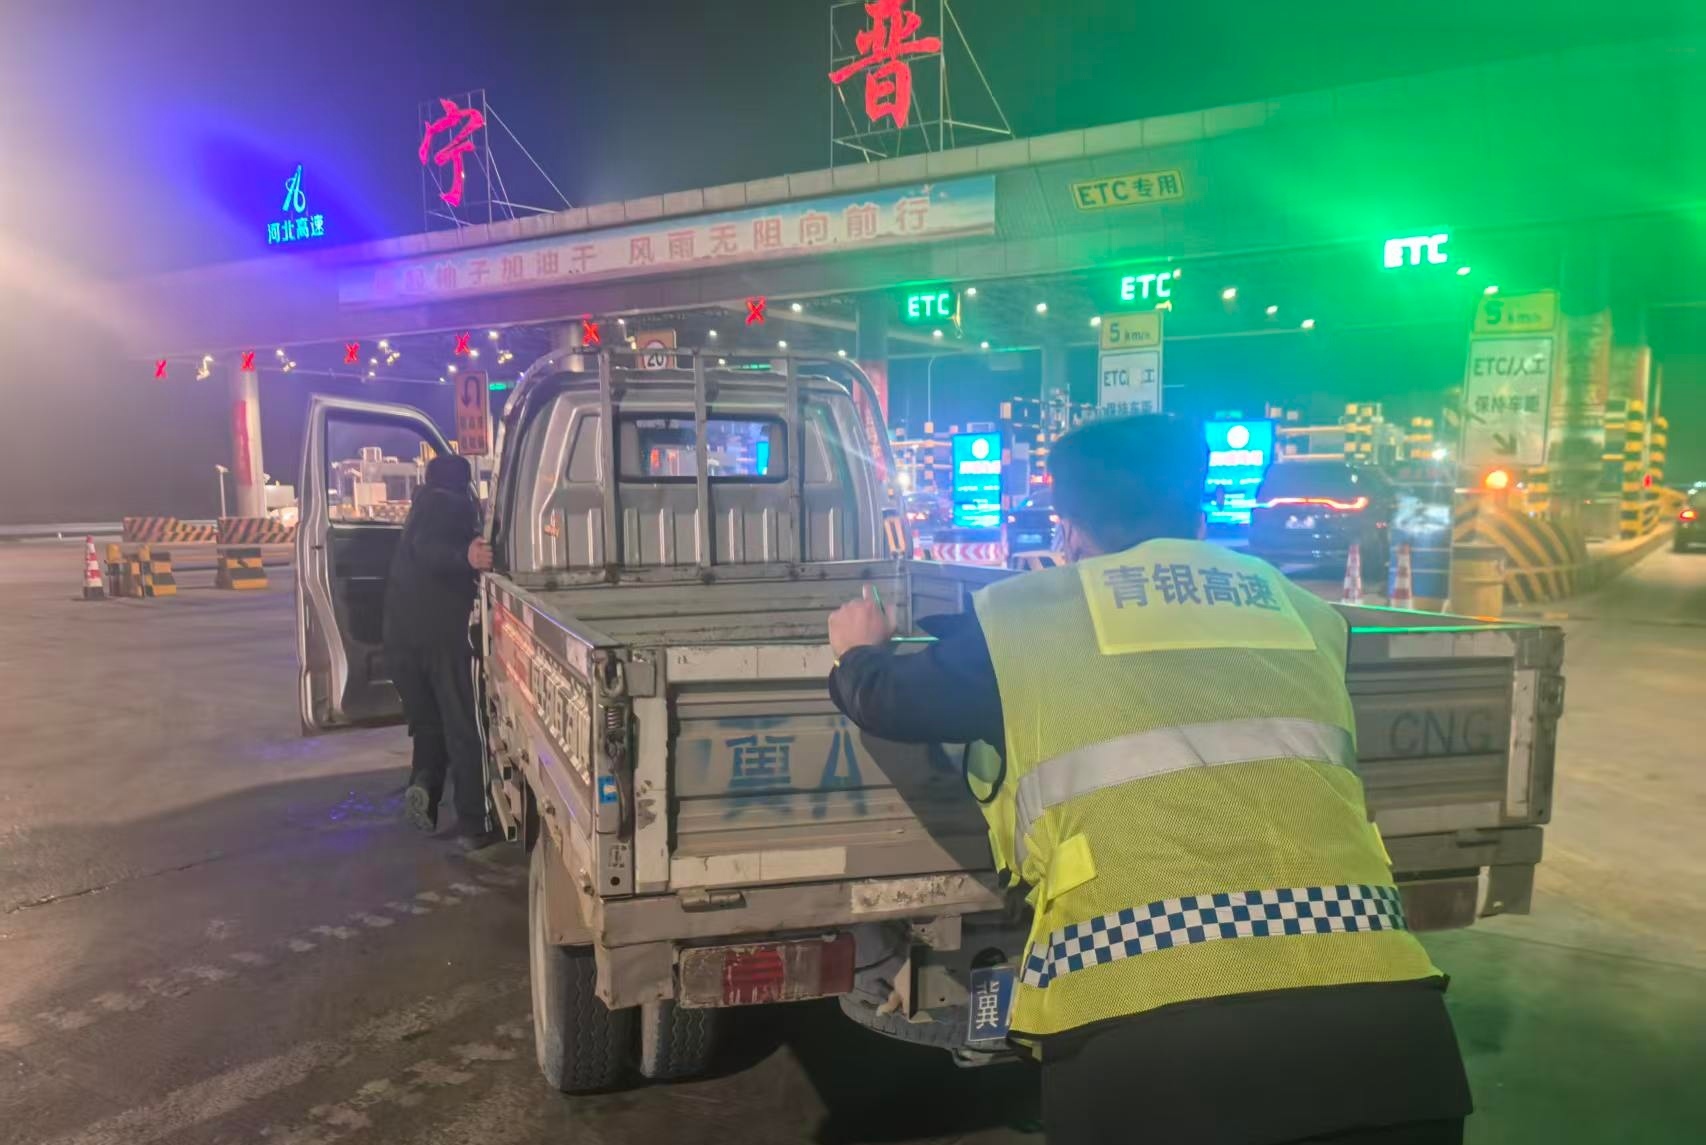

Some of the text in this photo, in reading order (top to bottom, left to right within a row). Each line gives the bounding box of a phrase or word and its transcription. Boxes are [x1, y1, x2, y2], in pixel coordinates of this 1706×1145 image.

[419, 0, 942, 207] 宁 晋
[1077, 174, 1179, 206] ETC专用
[267, 214, 325, 244] 河北高速
[629, 196, 930, 264] 风雨无阻向前行
[1383, 233, 1449, 268] ETC
[1121, 272, 1171, 300] ETC
[907, 293, 949, 317] ETC
[1110, 322, 1120, 342] 5
[647, 351, 664, 367] 20
[1103, 563, 1281, 611] 青银高速
[1390, 706, 1492, 755] CNG
